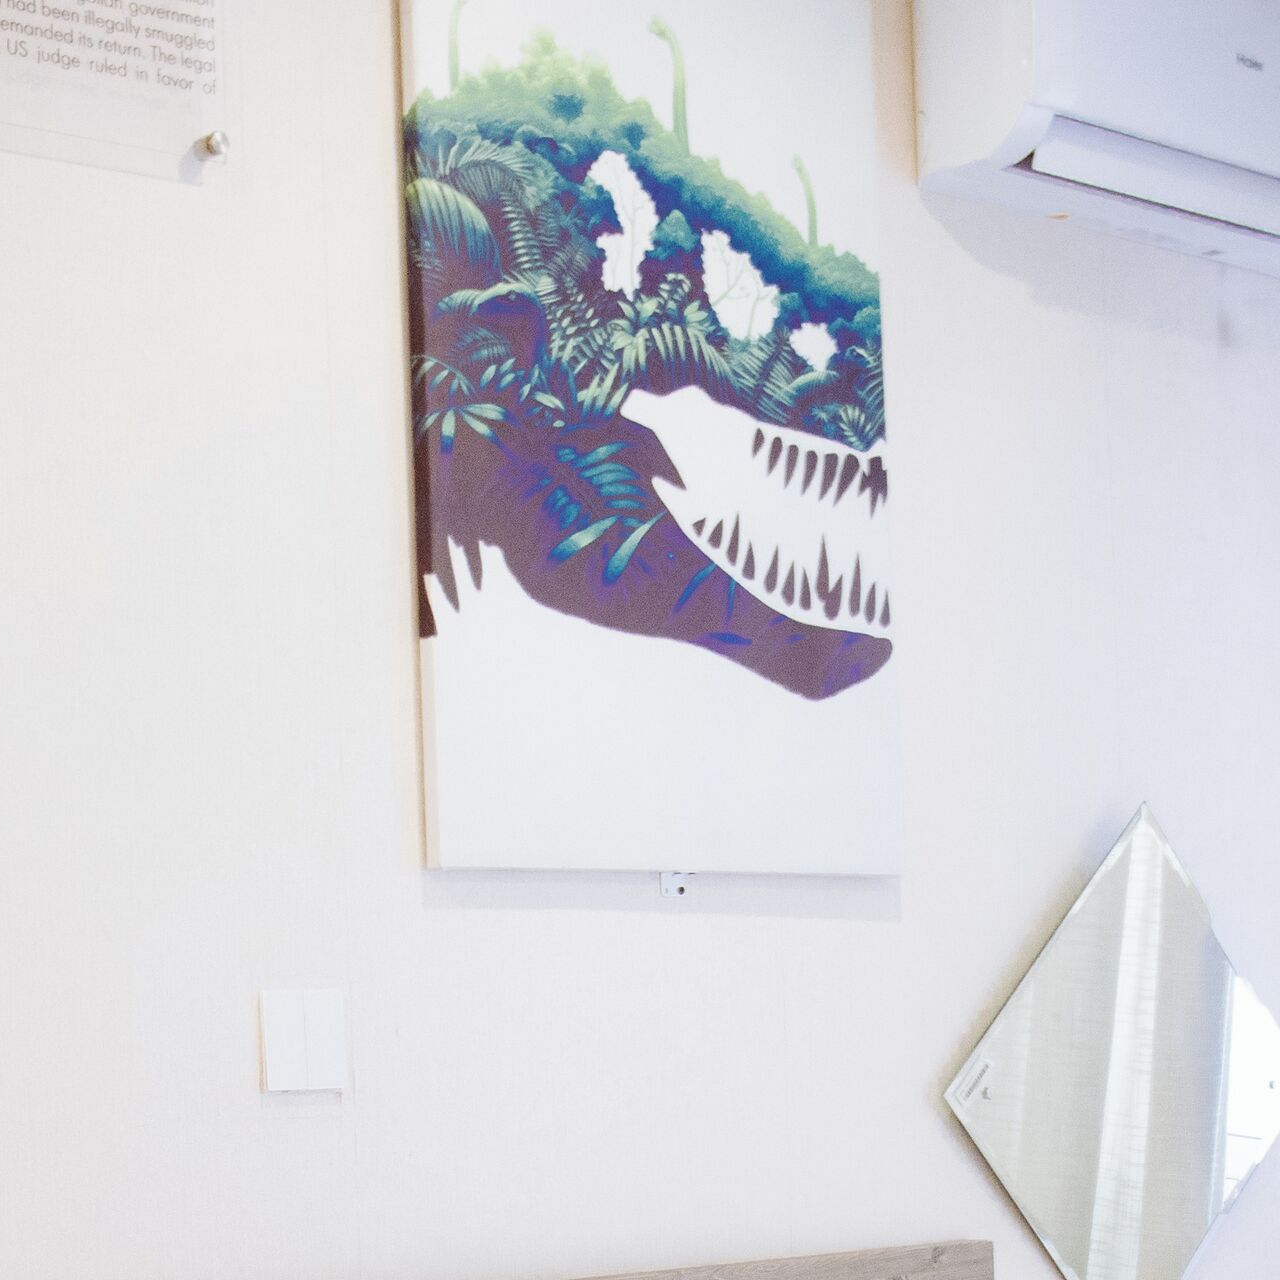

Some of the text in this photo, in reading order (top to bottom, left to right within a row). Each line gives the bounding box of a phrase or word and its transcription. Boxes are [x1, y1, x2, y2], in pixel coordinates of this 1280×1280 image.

[40, 0, 80, 23] been
[83, 10, 141, 38] illegally
[144, 27, 215, 51] smuggled
[128, 2, 215, 28] government
[6, 39, 29, 58] US
[37, 46, 81, 70] judge
[89, 59, 128, 78] ruled
[135, 65, 149, 81] in
[157, 67, 195, 91] favor
[202, 79, 216, 95] of
[78, 32, 94, 49] its
[150, 45, 177, 65] The
[180, 51, 216, 73] legal
